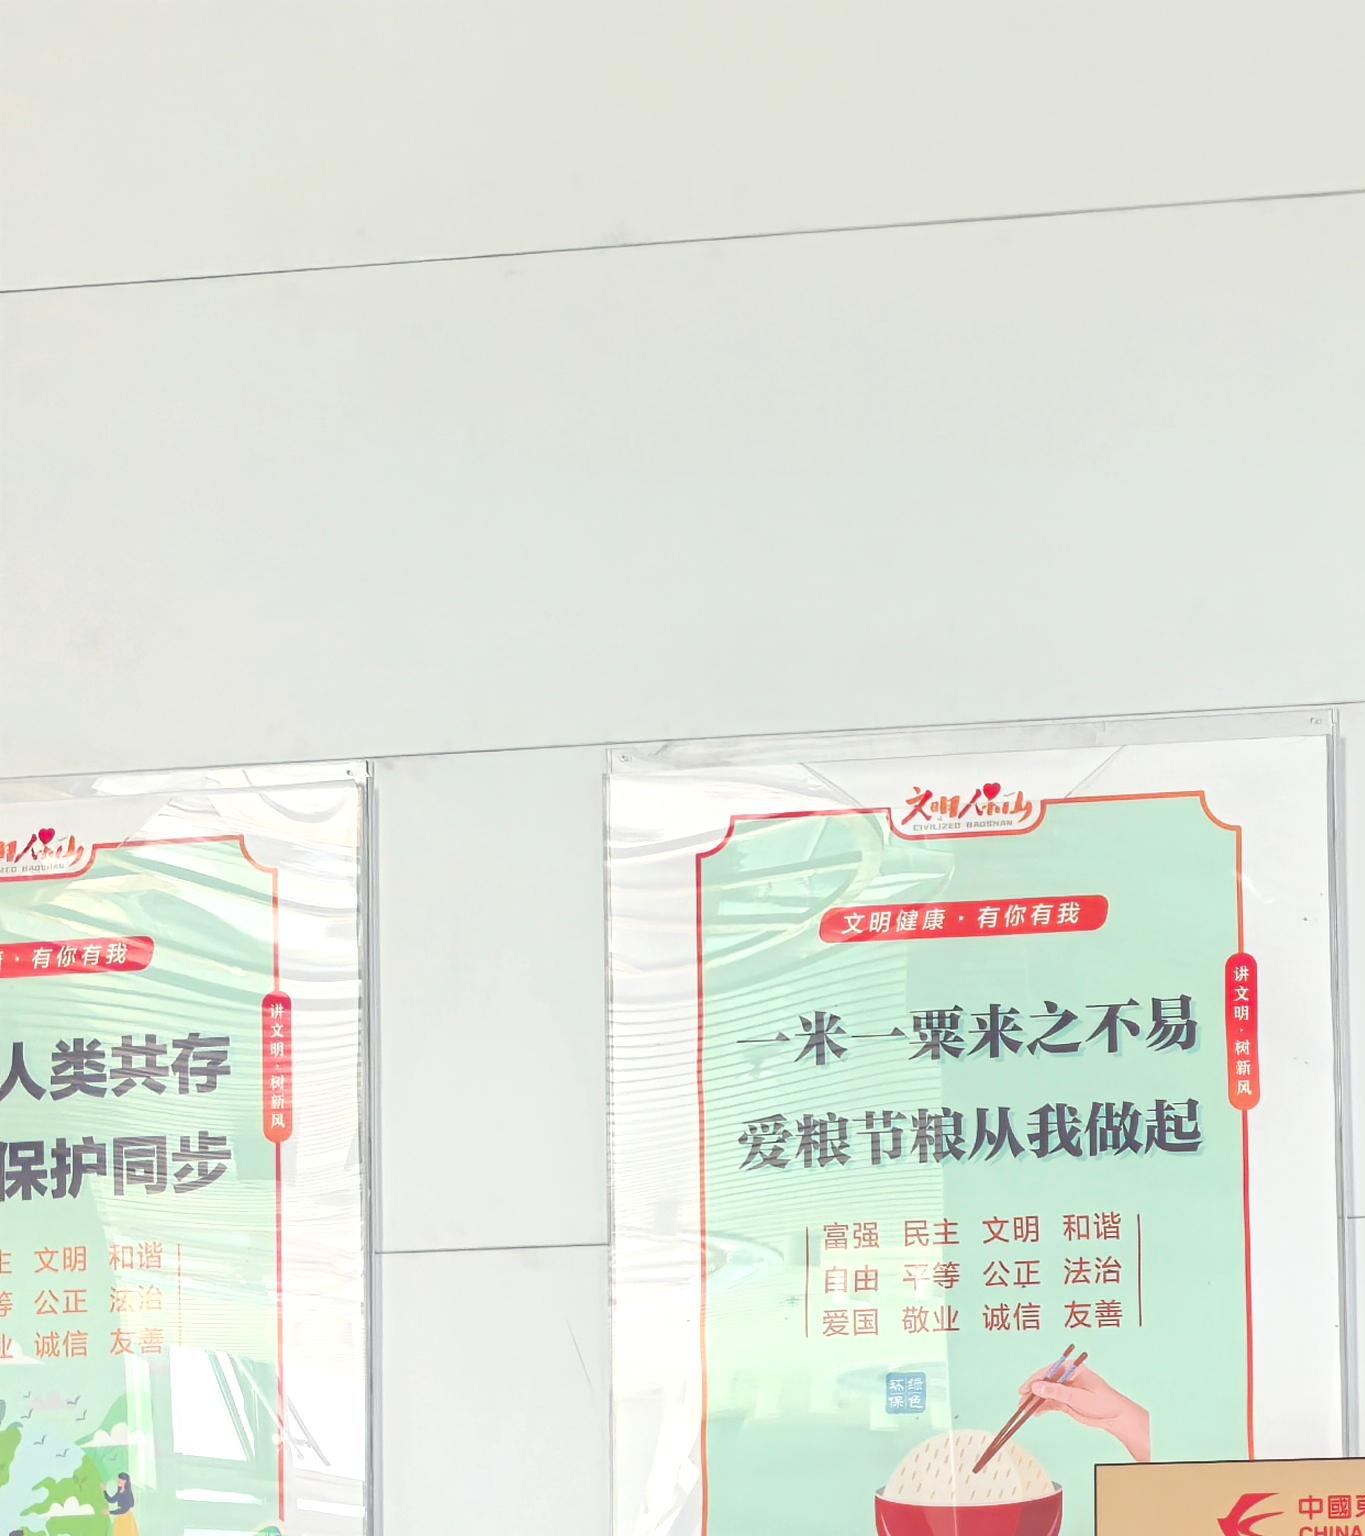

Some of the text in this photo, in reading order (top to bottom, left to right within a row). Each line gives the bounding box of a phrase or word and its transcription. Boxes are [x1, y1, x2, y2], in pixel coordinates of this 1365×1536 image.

[737, 994, 1199, 1067] 一米一粟来之不易
[0, 1033, 231, 1101] 人类共存
[738, 1097, 1204, 1172] 爱粮节粮从我做起
[0, 1131, 232, 1201] 保护同步
[823, 1211, 1122, 1250] 富强 民主 文明 和谐
[34, 1245, 88, 1274] 文明
[109, 1241, 163, 1272] 和谐
[823, 1256, 1122, 1294] 自由 平等 公正 法治
[34, 1287, 88, 1316] 公正
[822, 1300, 1123, 1338] 爱国 敬业 诚信 友善
[34, 1329, 89, 1359] 诚信
[110, 1327, 164, 1356] 友善
